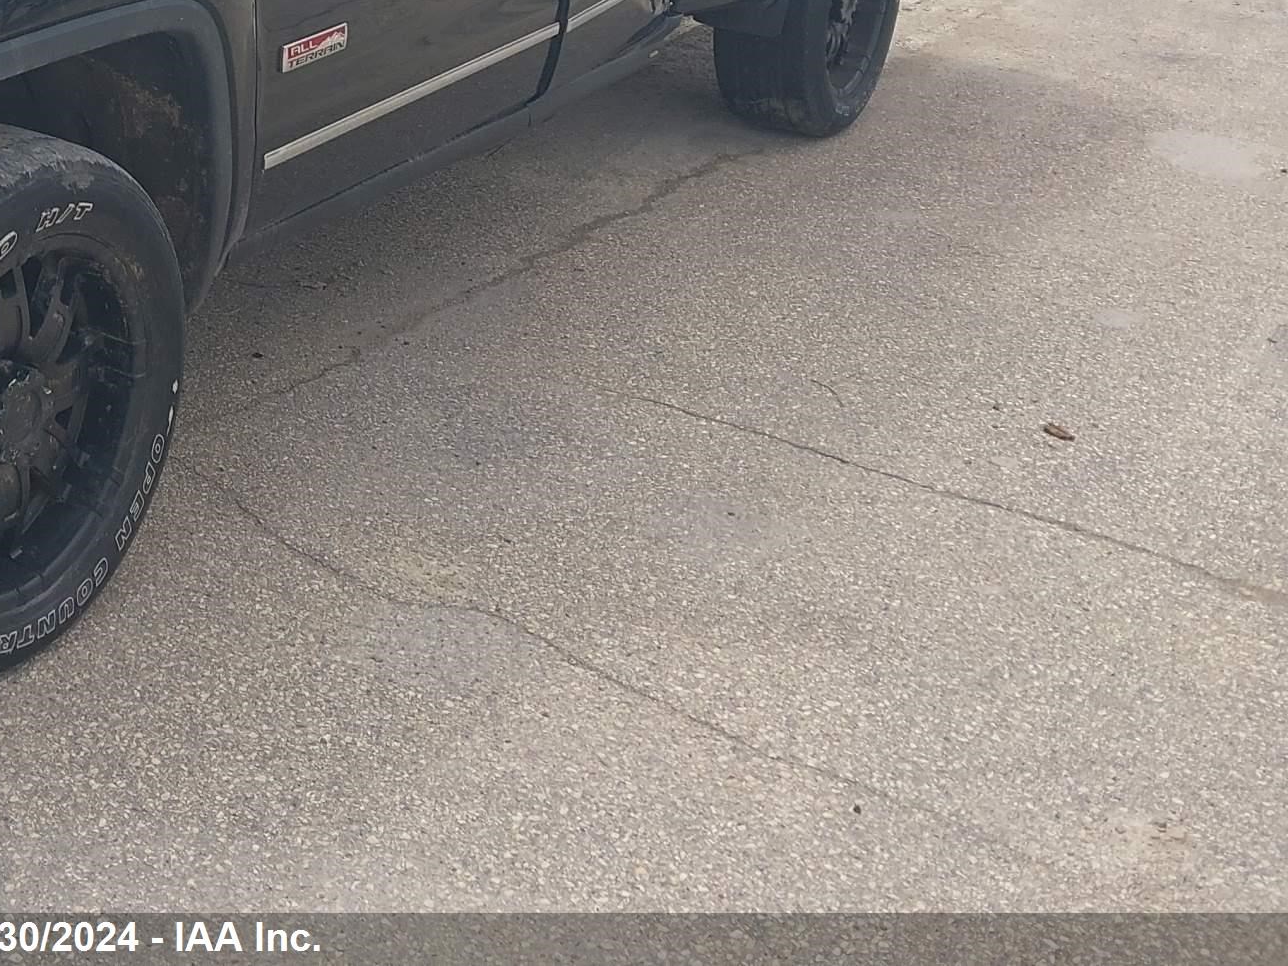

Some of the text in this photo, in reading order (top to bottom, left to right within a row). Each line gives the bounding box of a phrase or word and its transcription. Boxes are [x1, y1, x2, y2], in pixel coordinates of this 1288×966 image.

[287, 40, 345, 69] TERRAIN
[290, 39, 319, 58] ALL
[35, 201, 94, 233] H/T
[114, 433, 165, 552] OPEN
